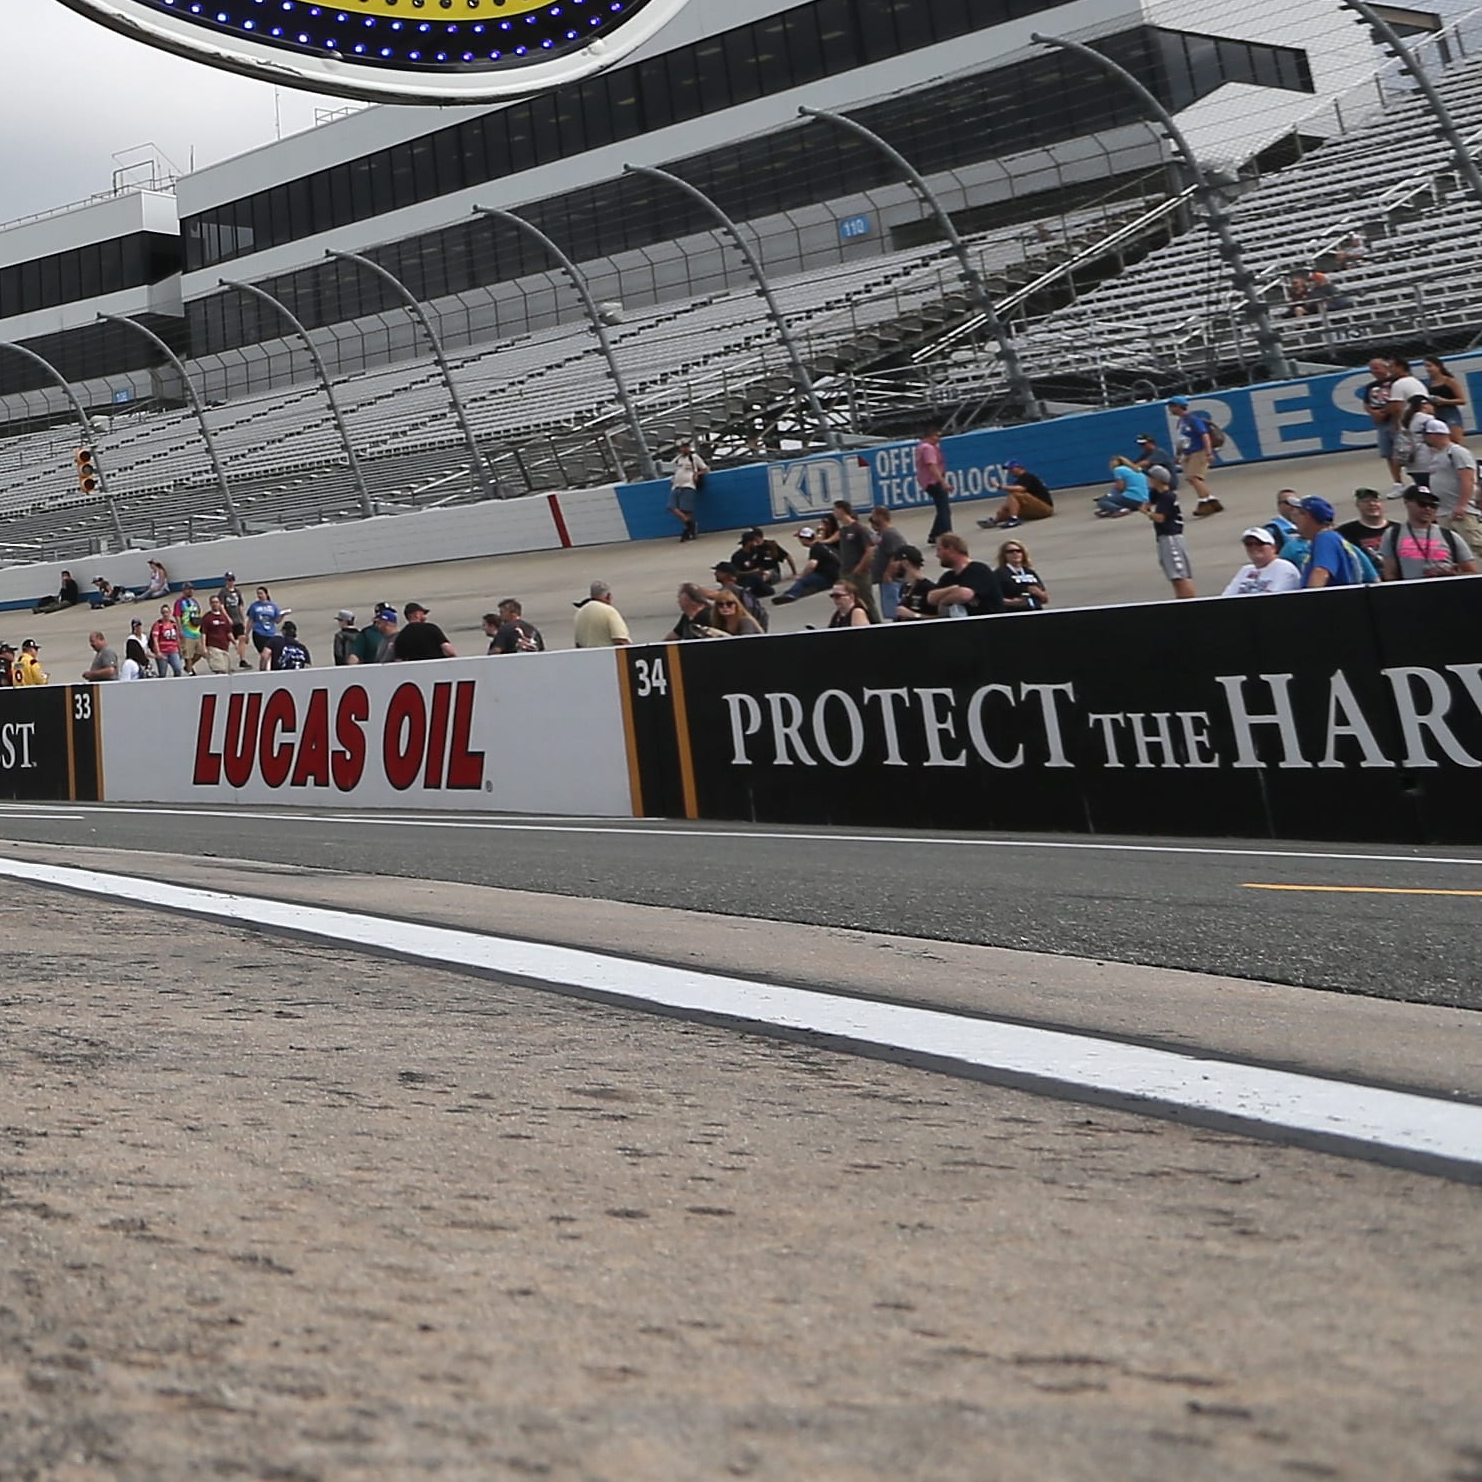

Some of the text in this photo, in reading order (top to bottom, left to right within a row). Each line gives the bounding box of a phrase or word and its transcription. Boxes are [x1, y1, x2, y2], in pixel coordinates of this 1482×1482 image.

[74, 693, 92, 720] 33
[635, 657, 668, 697] 34
[192, 680, 485, 792] LUCAS OIL
[722, 682, 1076, 769] PROTECT
[1087, 711, 1220, 770] THE
